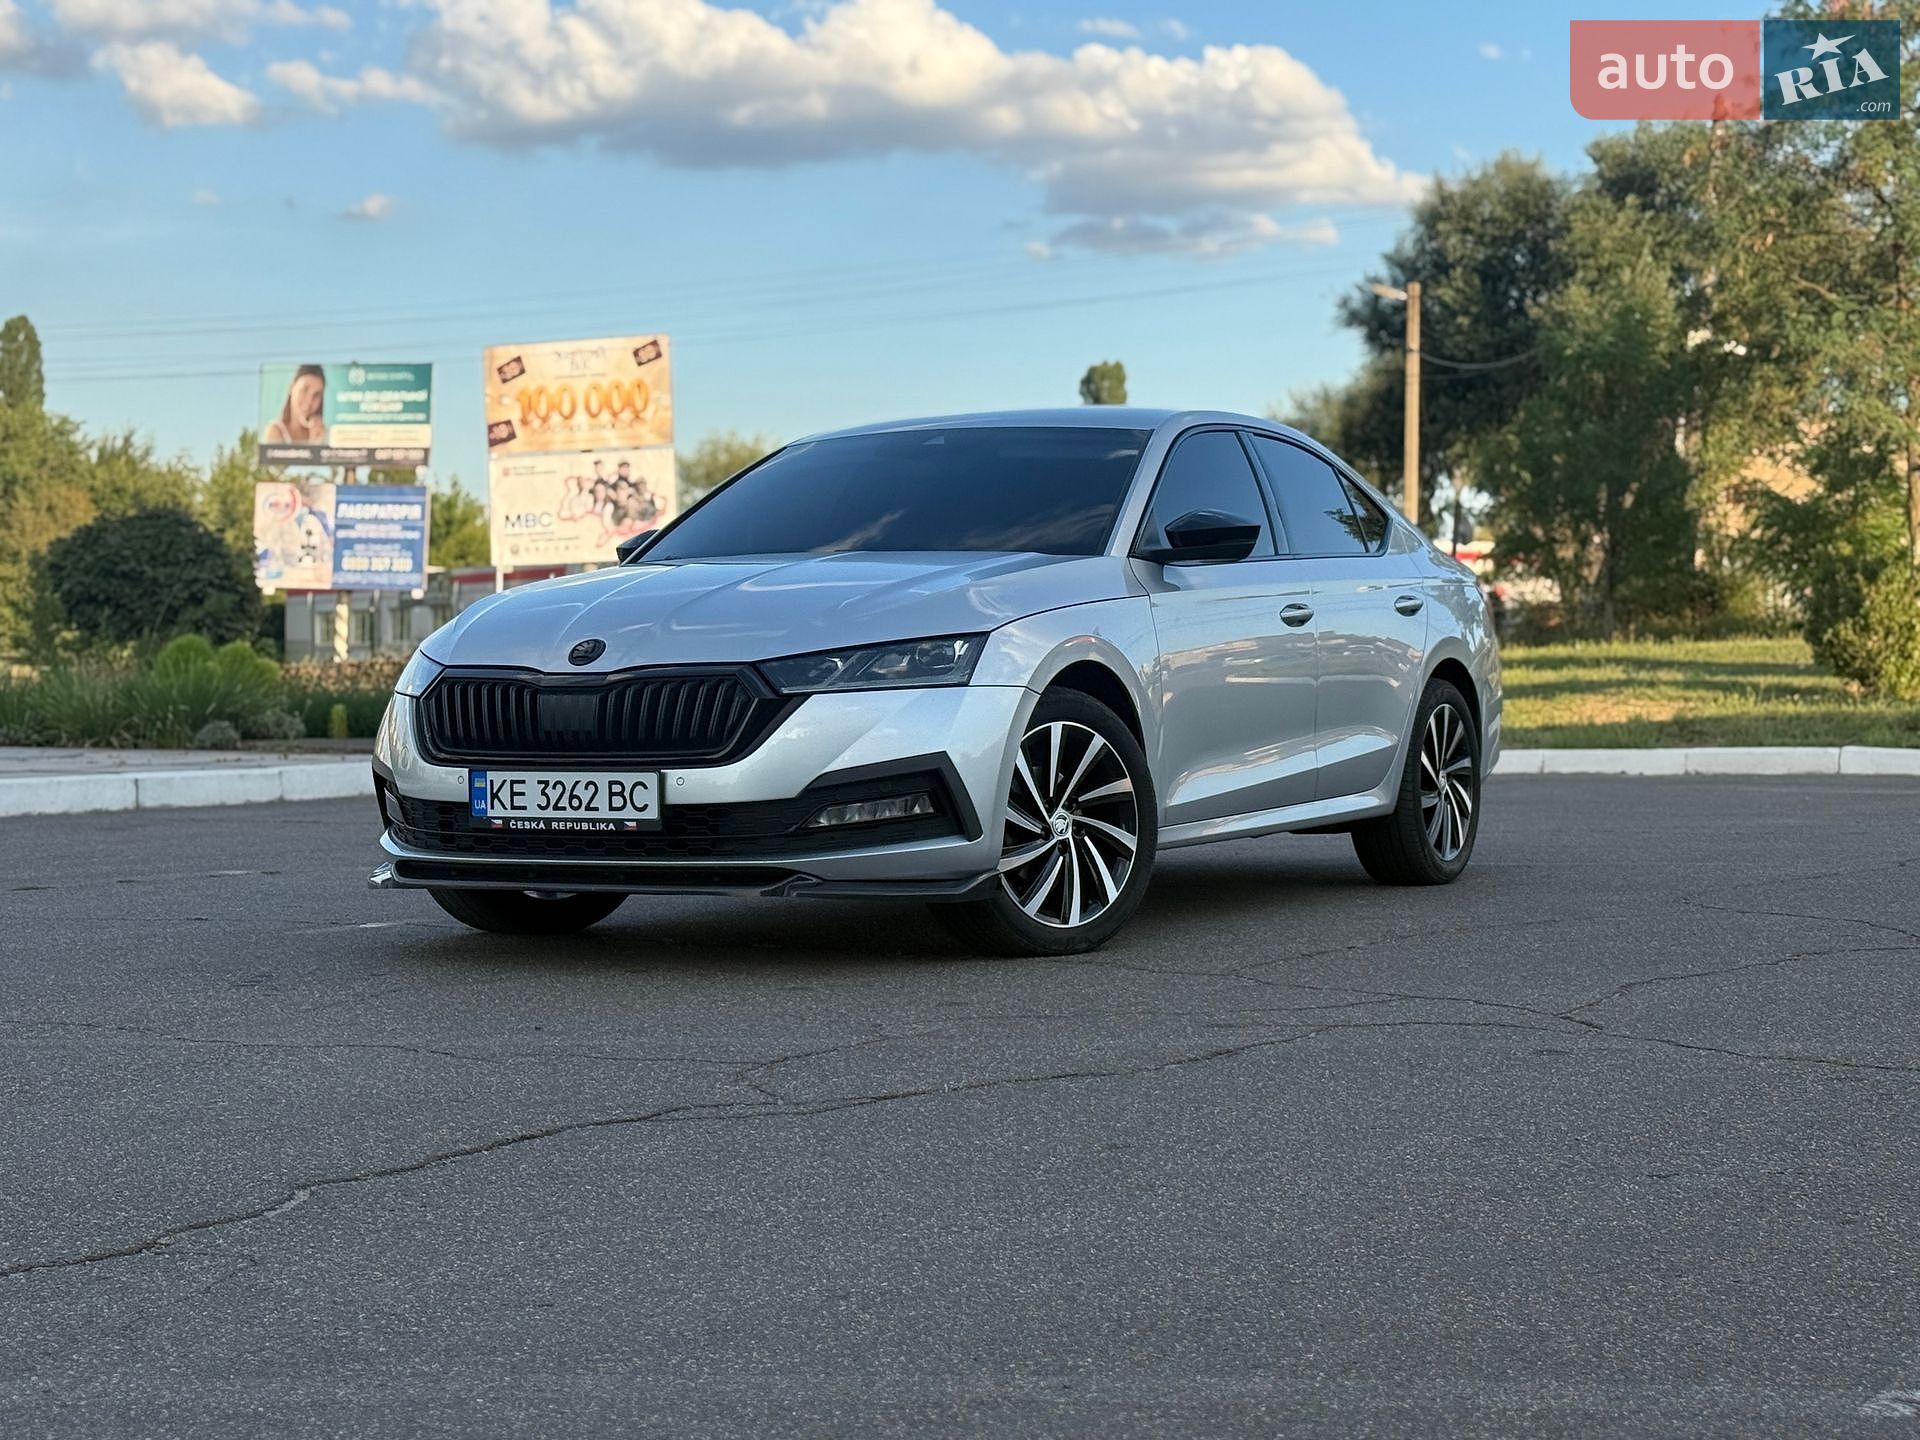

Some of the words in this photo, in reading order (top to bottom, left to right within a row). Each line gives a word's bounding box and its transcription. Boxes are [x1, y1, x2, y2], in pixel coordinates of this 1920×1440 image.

[489, 779, 528, 811] KE
[536, 779, 600, 812] 3262
[607, 780, 649, 812] BC
[474, 801, 486, 810] UA
[509, 819, 546, 830] ČESKÁ
[551, 821, 616, 831] REPUBLIKA
